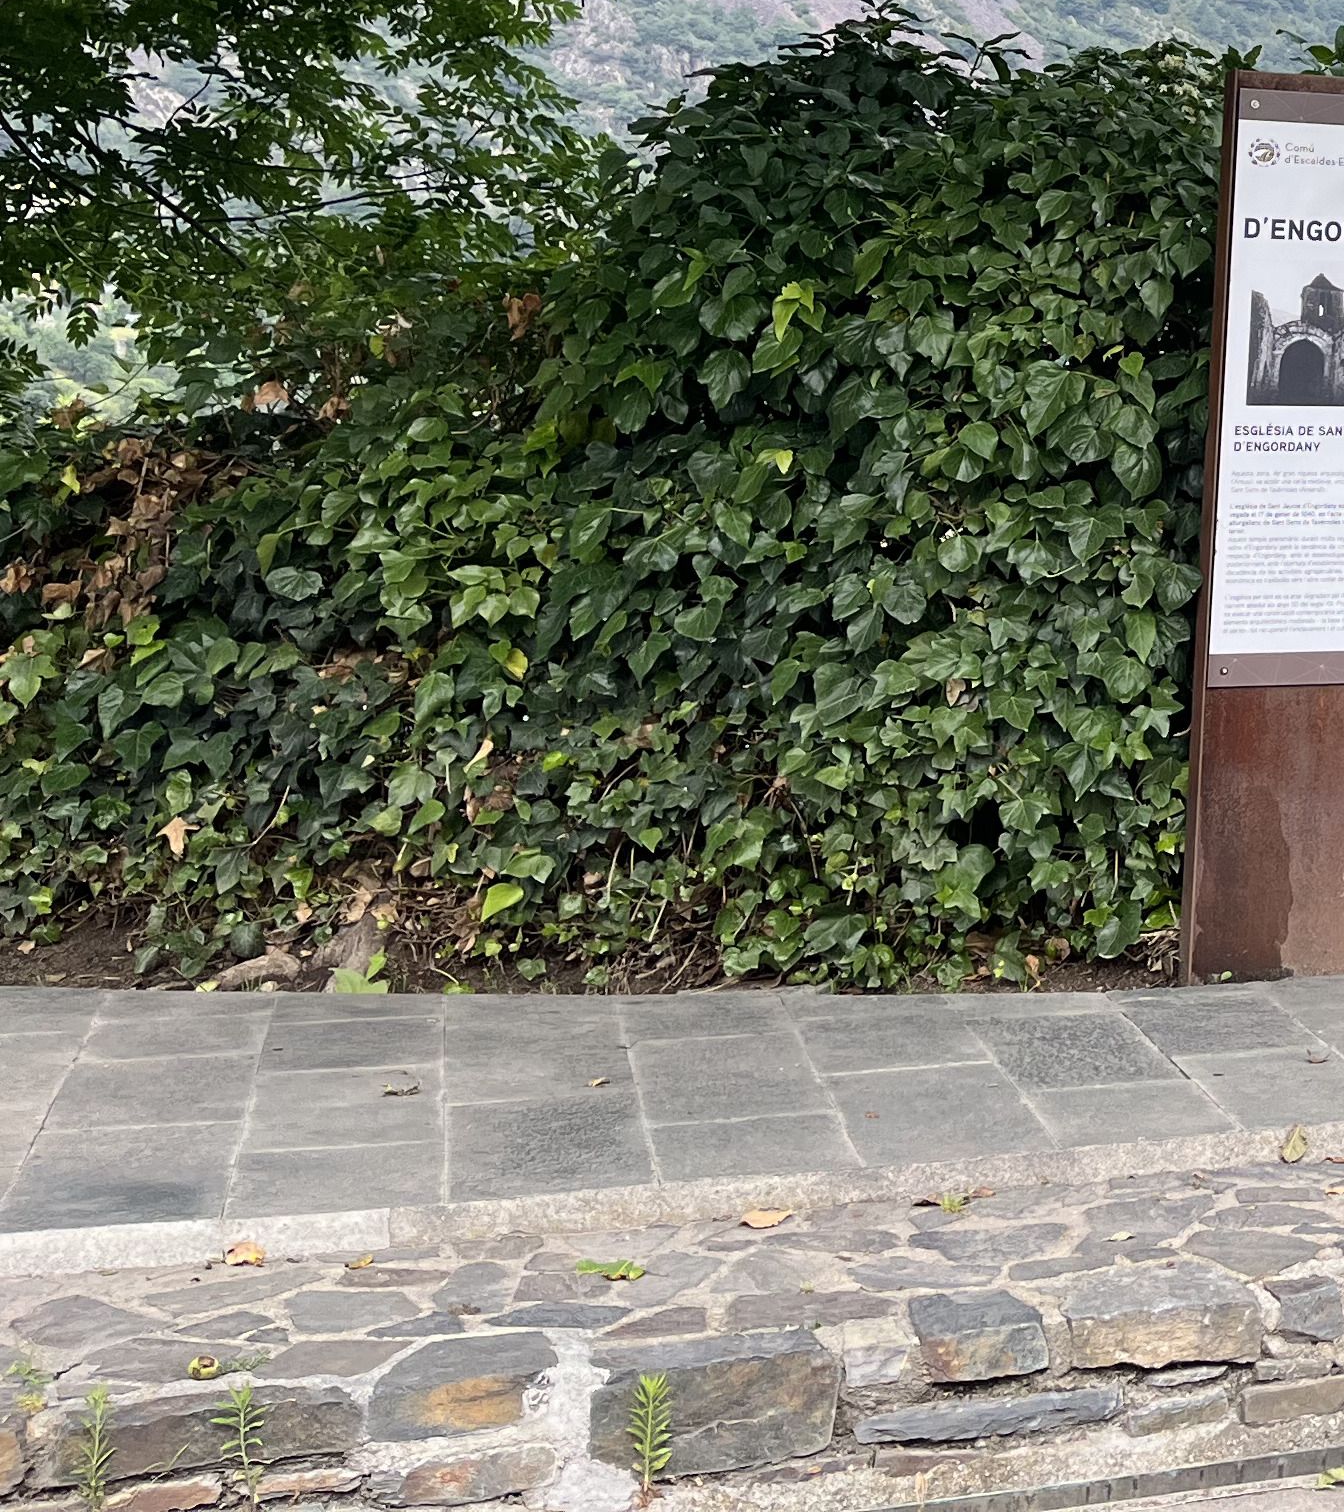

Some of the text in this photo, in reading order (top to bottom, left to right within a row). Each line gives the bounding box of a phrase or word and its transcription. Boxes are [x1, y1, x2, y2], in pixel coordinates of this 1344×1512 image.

[1284, 142, 1315, 153] Comú
[1234, 423, 1294, 436] ESGLÉSIA
[1298, 425, 1314, 436] DE
[1233, 441, 1321, 452] D'ENGORDANY
